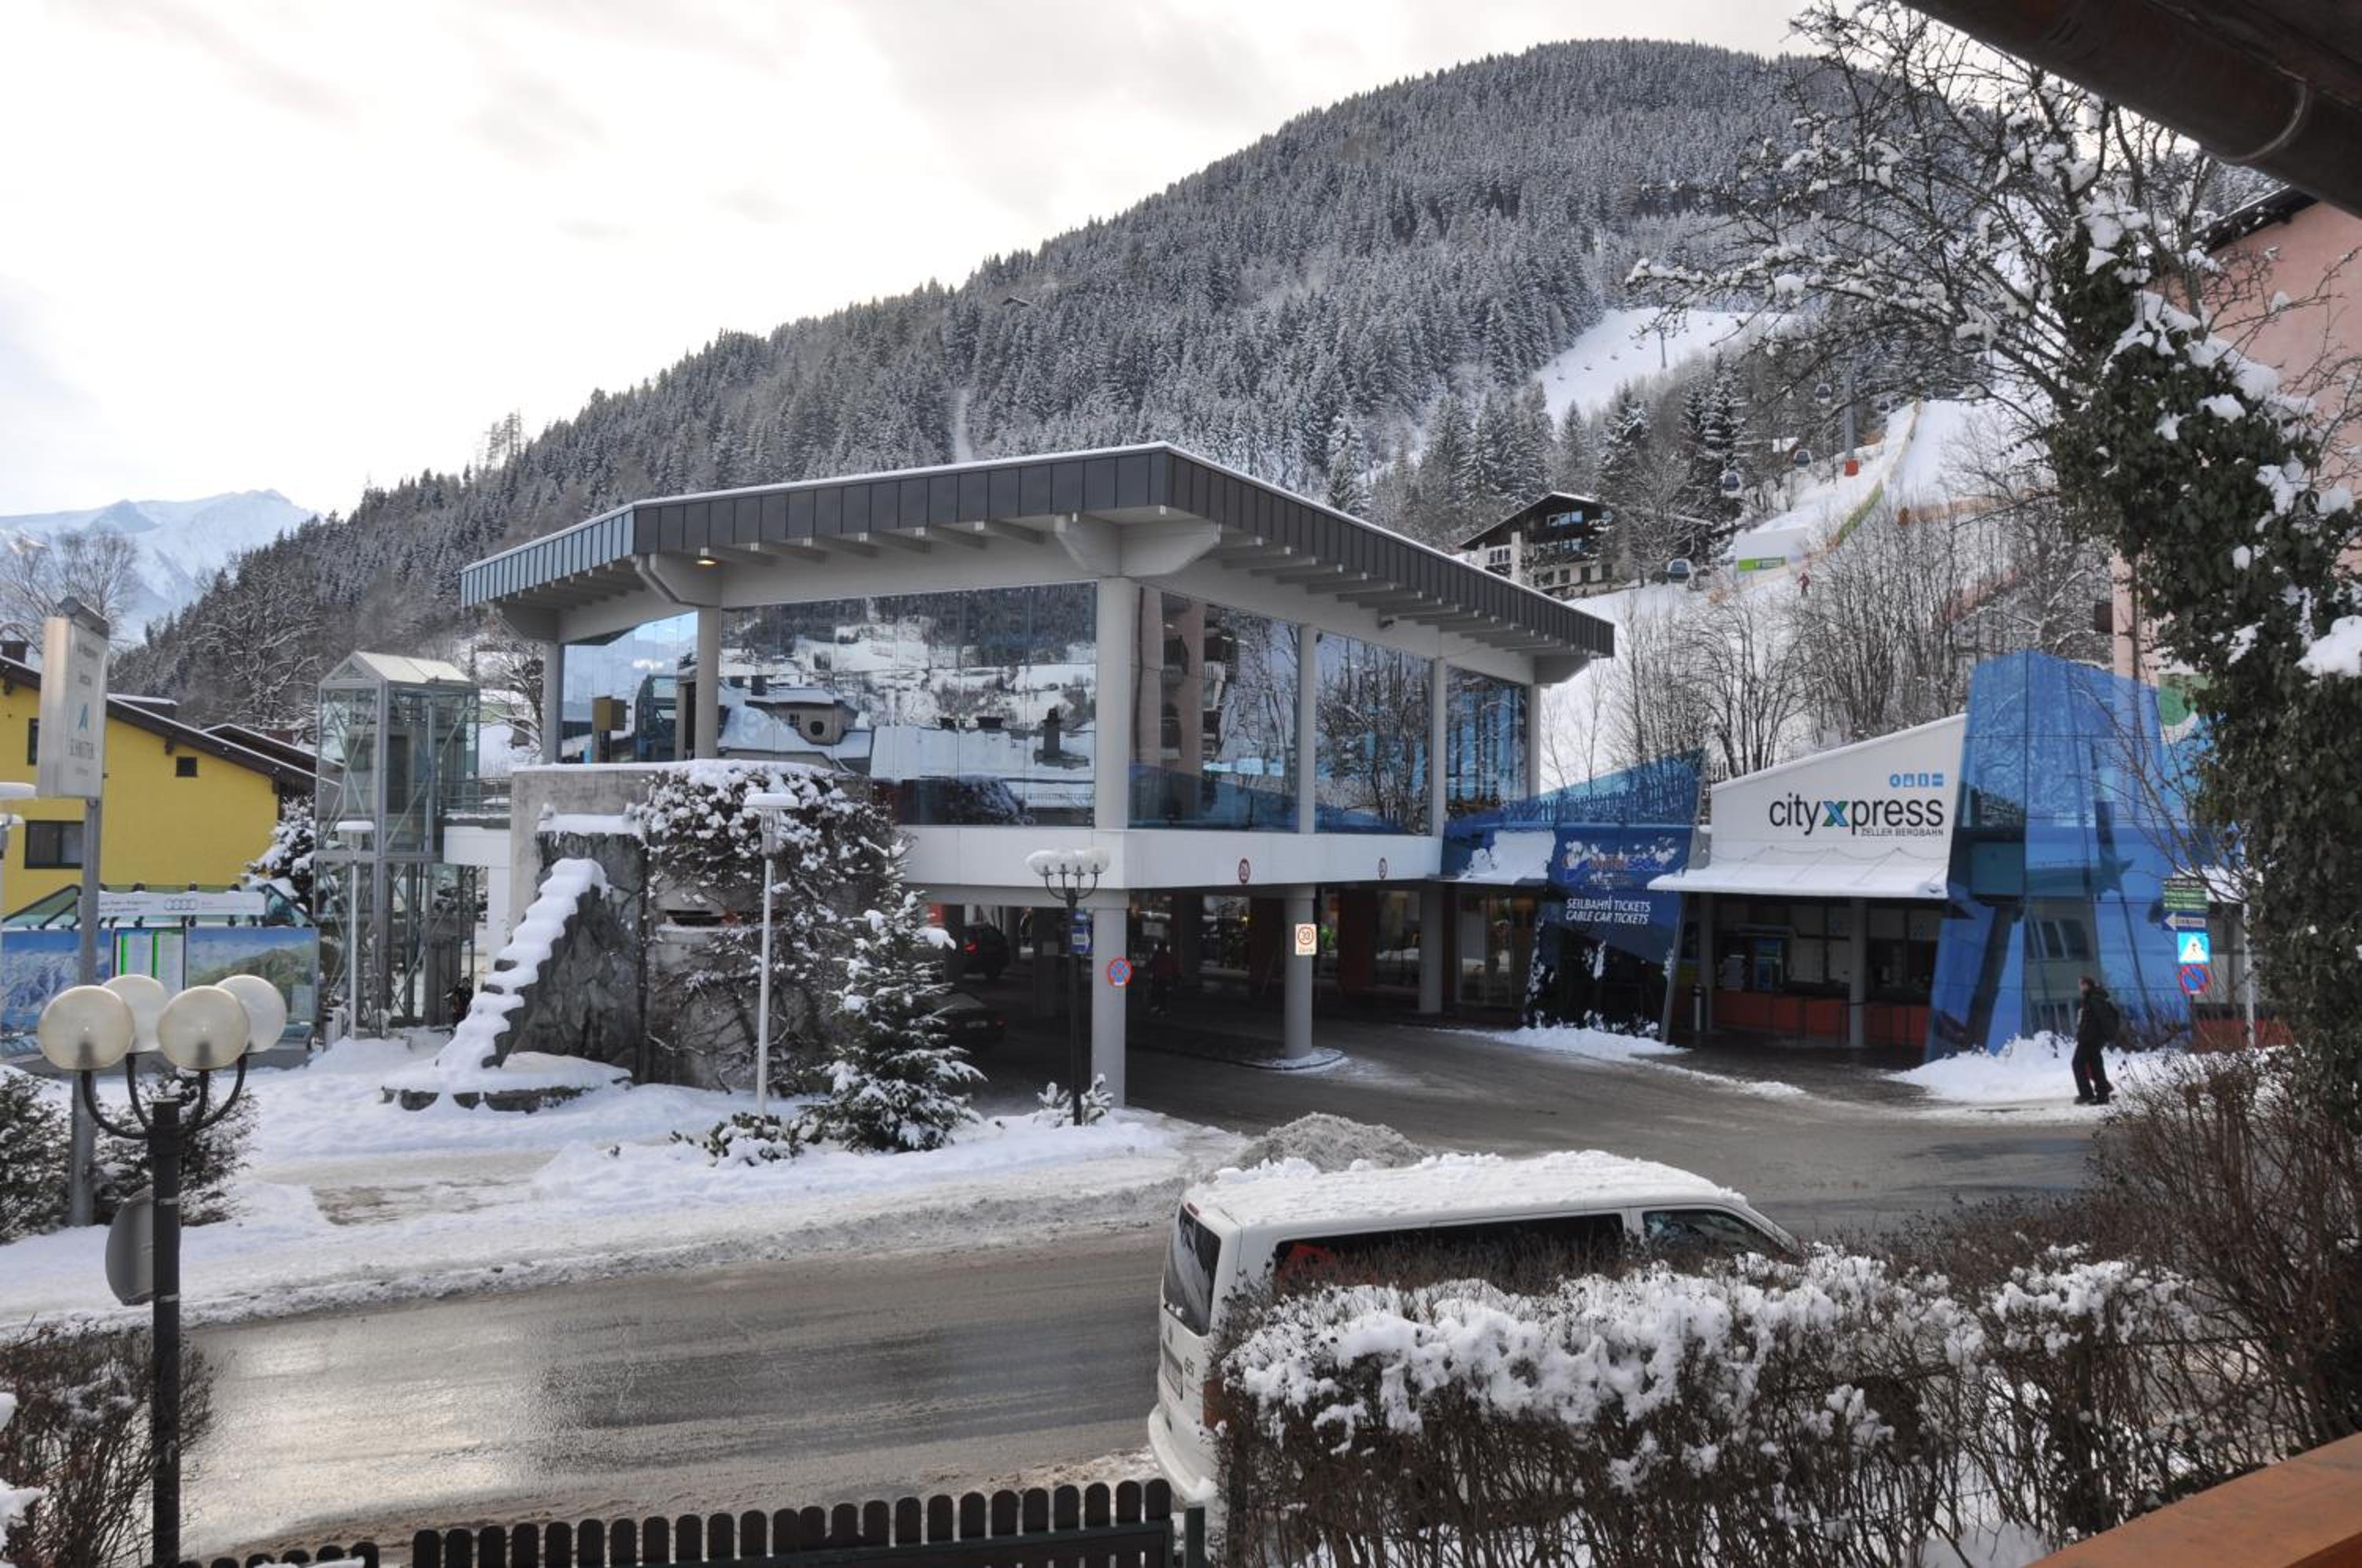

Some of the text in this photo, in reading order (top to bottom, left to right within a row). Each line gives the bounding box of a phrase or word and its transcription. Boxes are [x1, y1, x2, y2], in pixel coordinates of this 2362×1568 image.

[1860, 827, 1944, 836] ZELLER BERGBAHN
[1566, 898, 1651, 913] SEILBAHN TICKETS
[1565, 911, 1649, 925] CABLE CAR TICKETS
